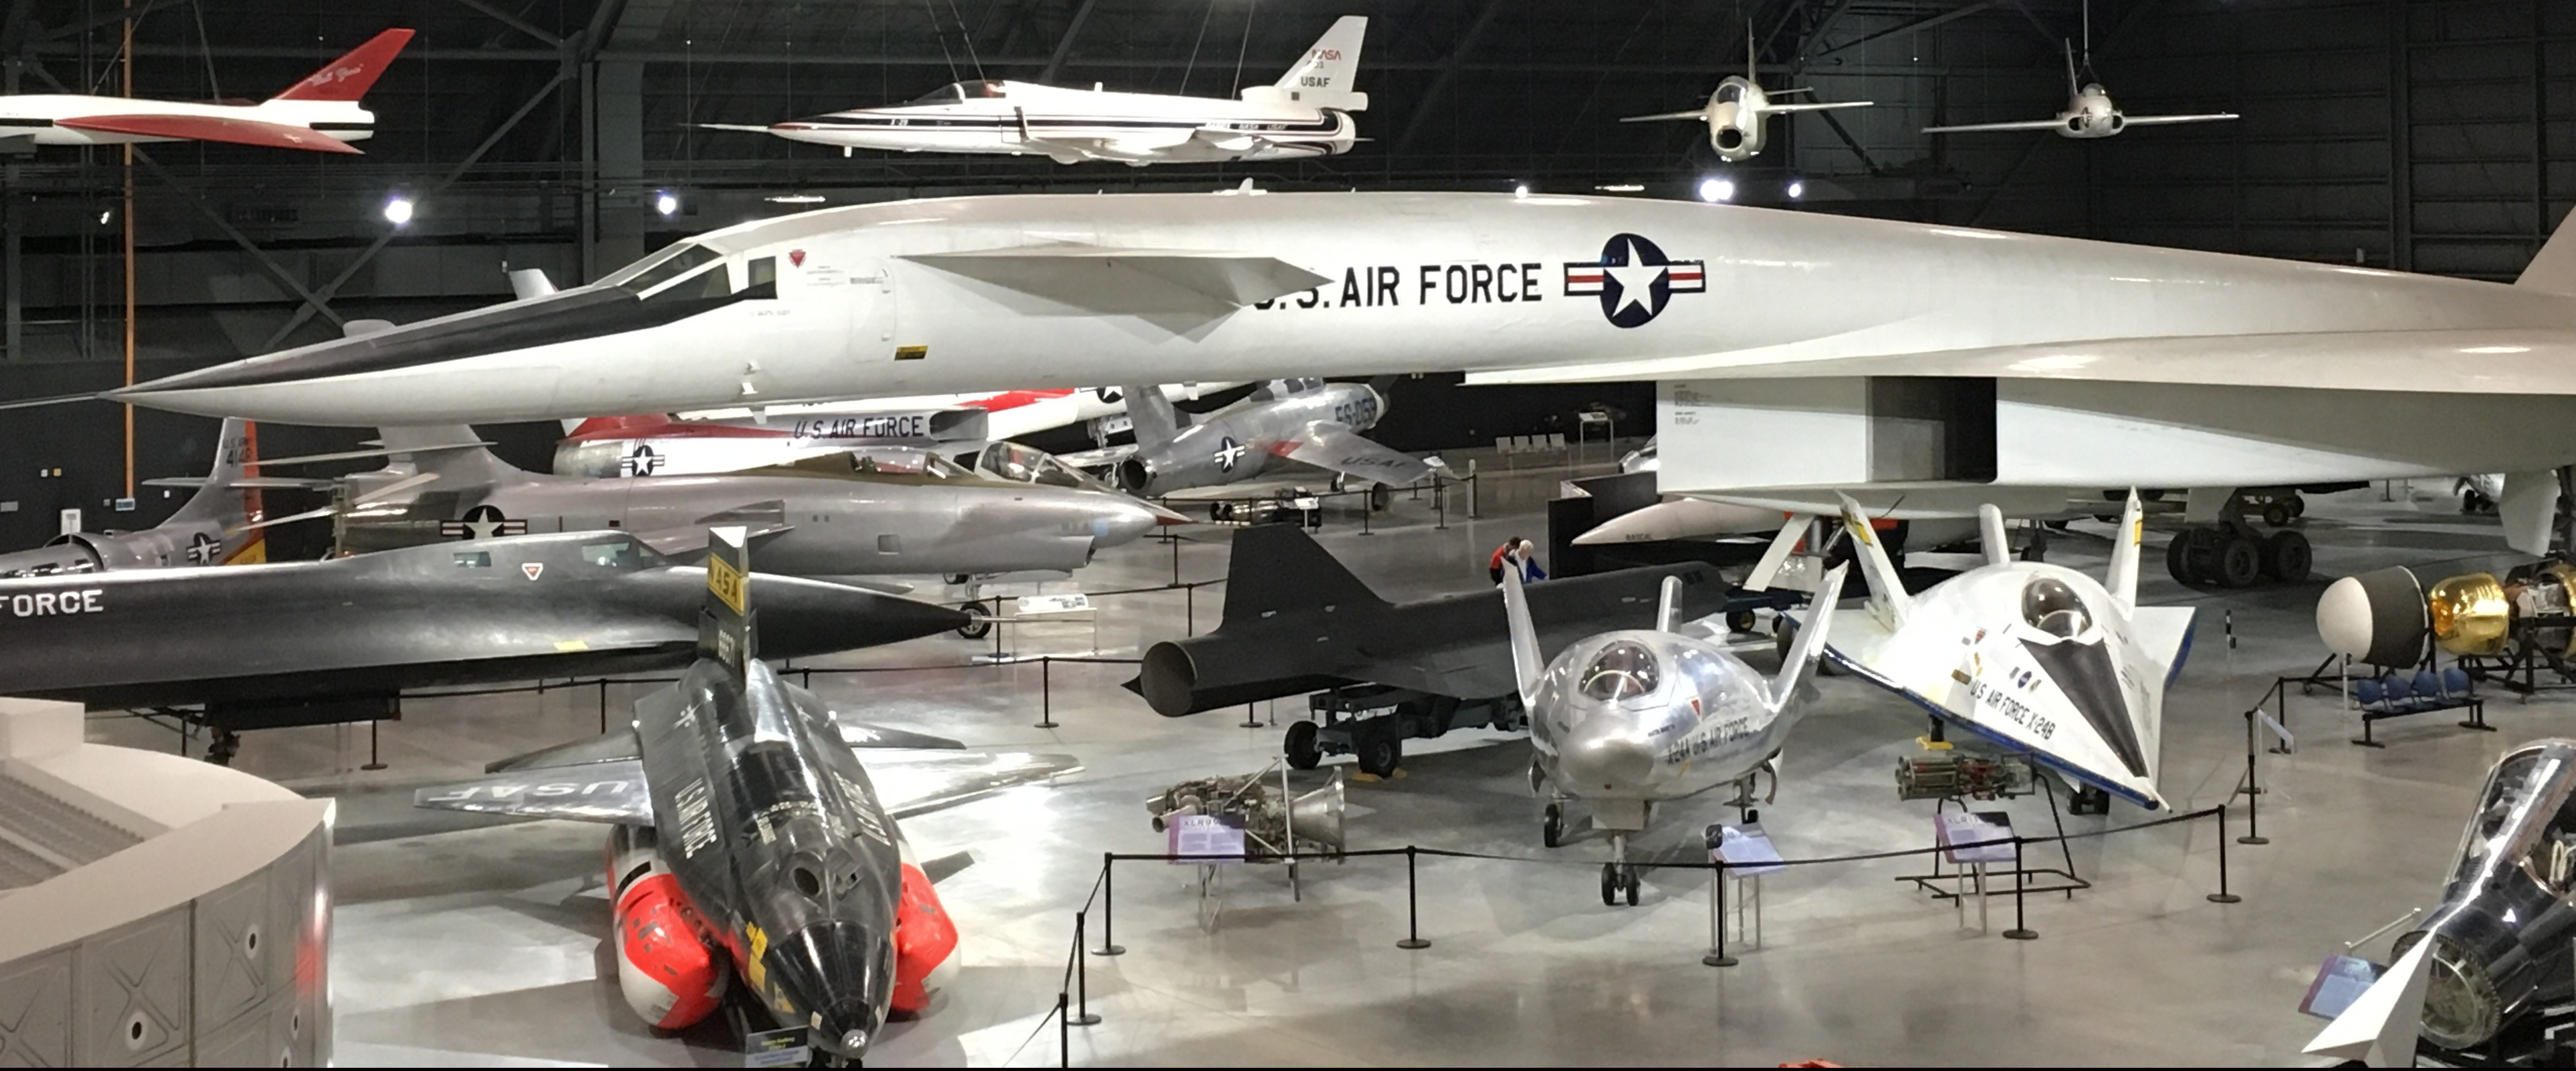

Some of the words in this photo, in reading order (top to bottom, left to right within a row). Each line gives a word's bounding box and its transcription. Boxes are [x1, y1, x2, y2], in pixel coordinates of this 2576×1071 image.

[1312, 49, 1342, 61] NASA
[1301, 76, 1330, 87] USAF
[1340, 266, 1399, 307] AIR
[1420, 263, 1542, 305] FORCE
[831, 419, 856, 438] AIR
[864, 416, 924, 437] FORCE
[709, 559, 738, 603] NASA
[1985, 690, 2002, 709] AIR
[1999, 696, 2030, 725] FORCE
[2025, 712, 2055, 740] X-24B
[427, 780, 629, 801] USAF
[681, 810, 717, 859] FORCE
